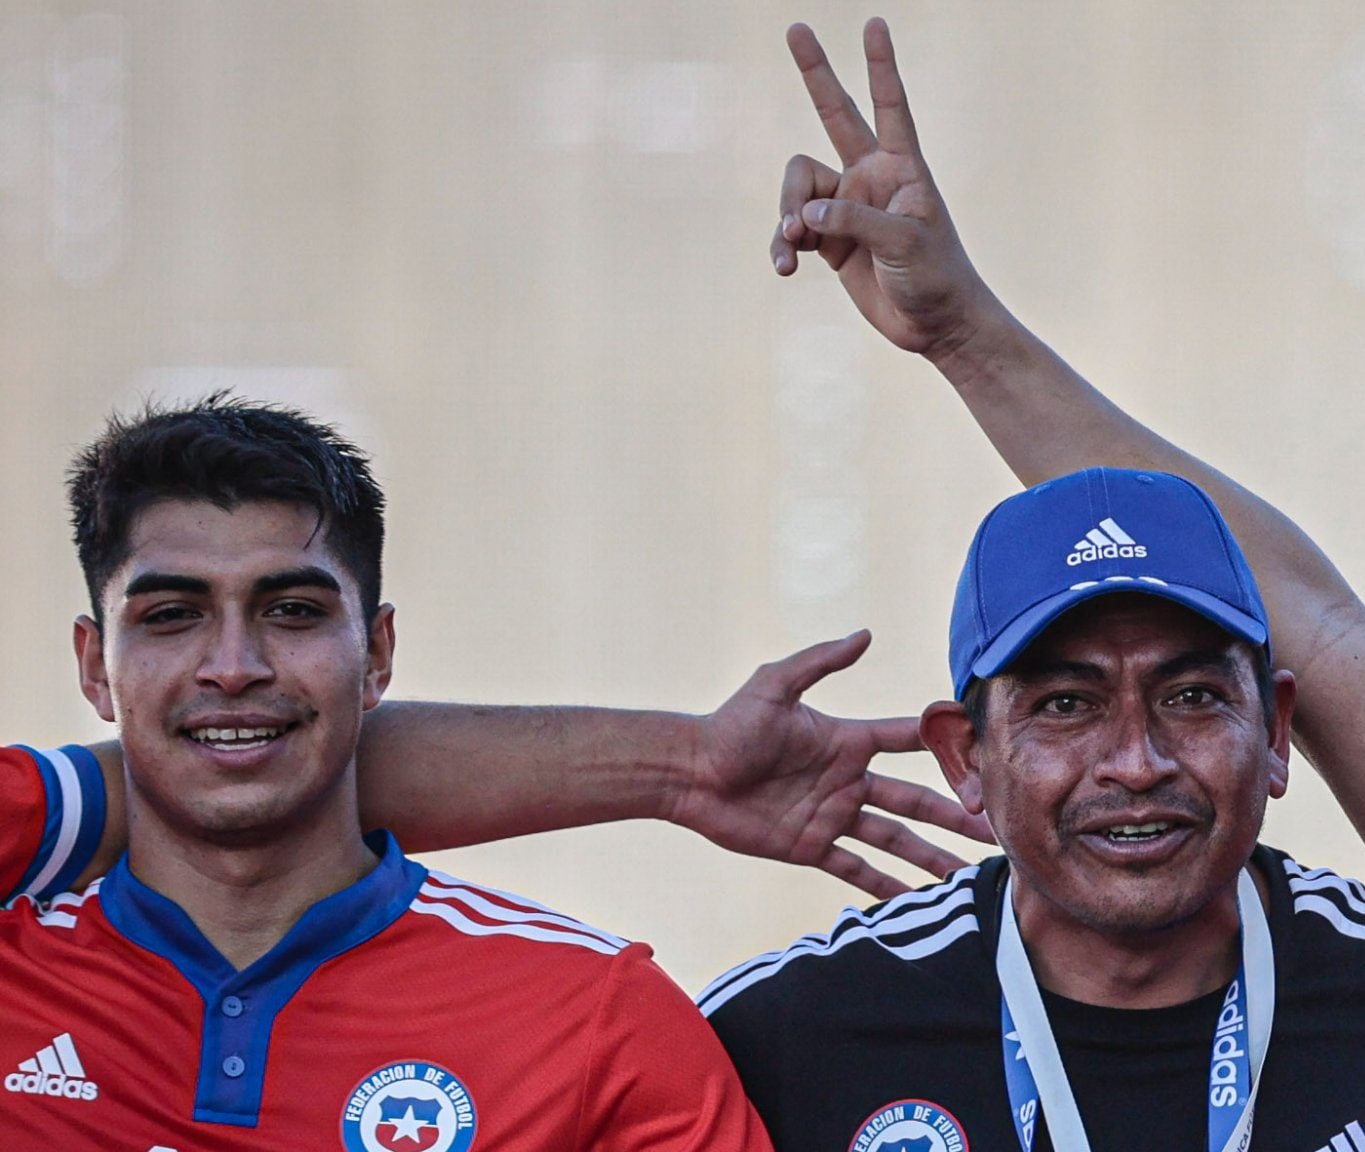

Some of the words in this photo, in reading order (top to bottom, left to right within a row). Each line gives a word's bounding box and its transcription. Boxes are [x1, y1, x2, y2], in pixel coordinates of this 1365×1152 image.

[1066, 543, 1148, 566] adidas
[1210, 979, 1244, 1107] adidas
[4, 1071, 98, 1101] adidas
[345, 1064, 416, 1122] FEDERACION
[424, 1067, 445, 1085] DE
[444, 1081, 473, 1130] FUTBOL
[913, 1105, 932, 1121] DE
